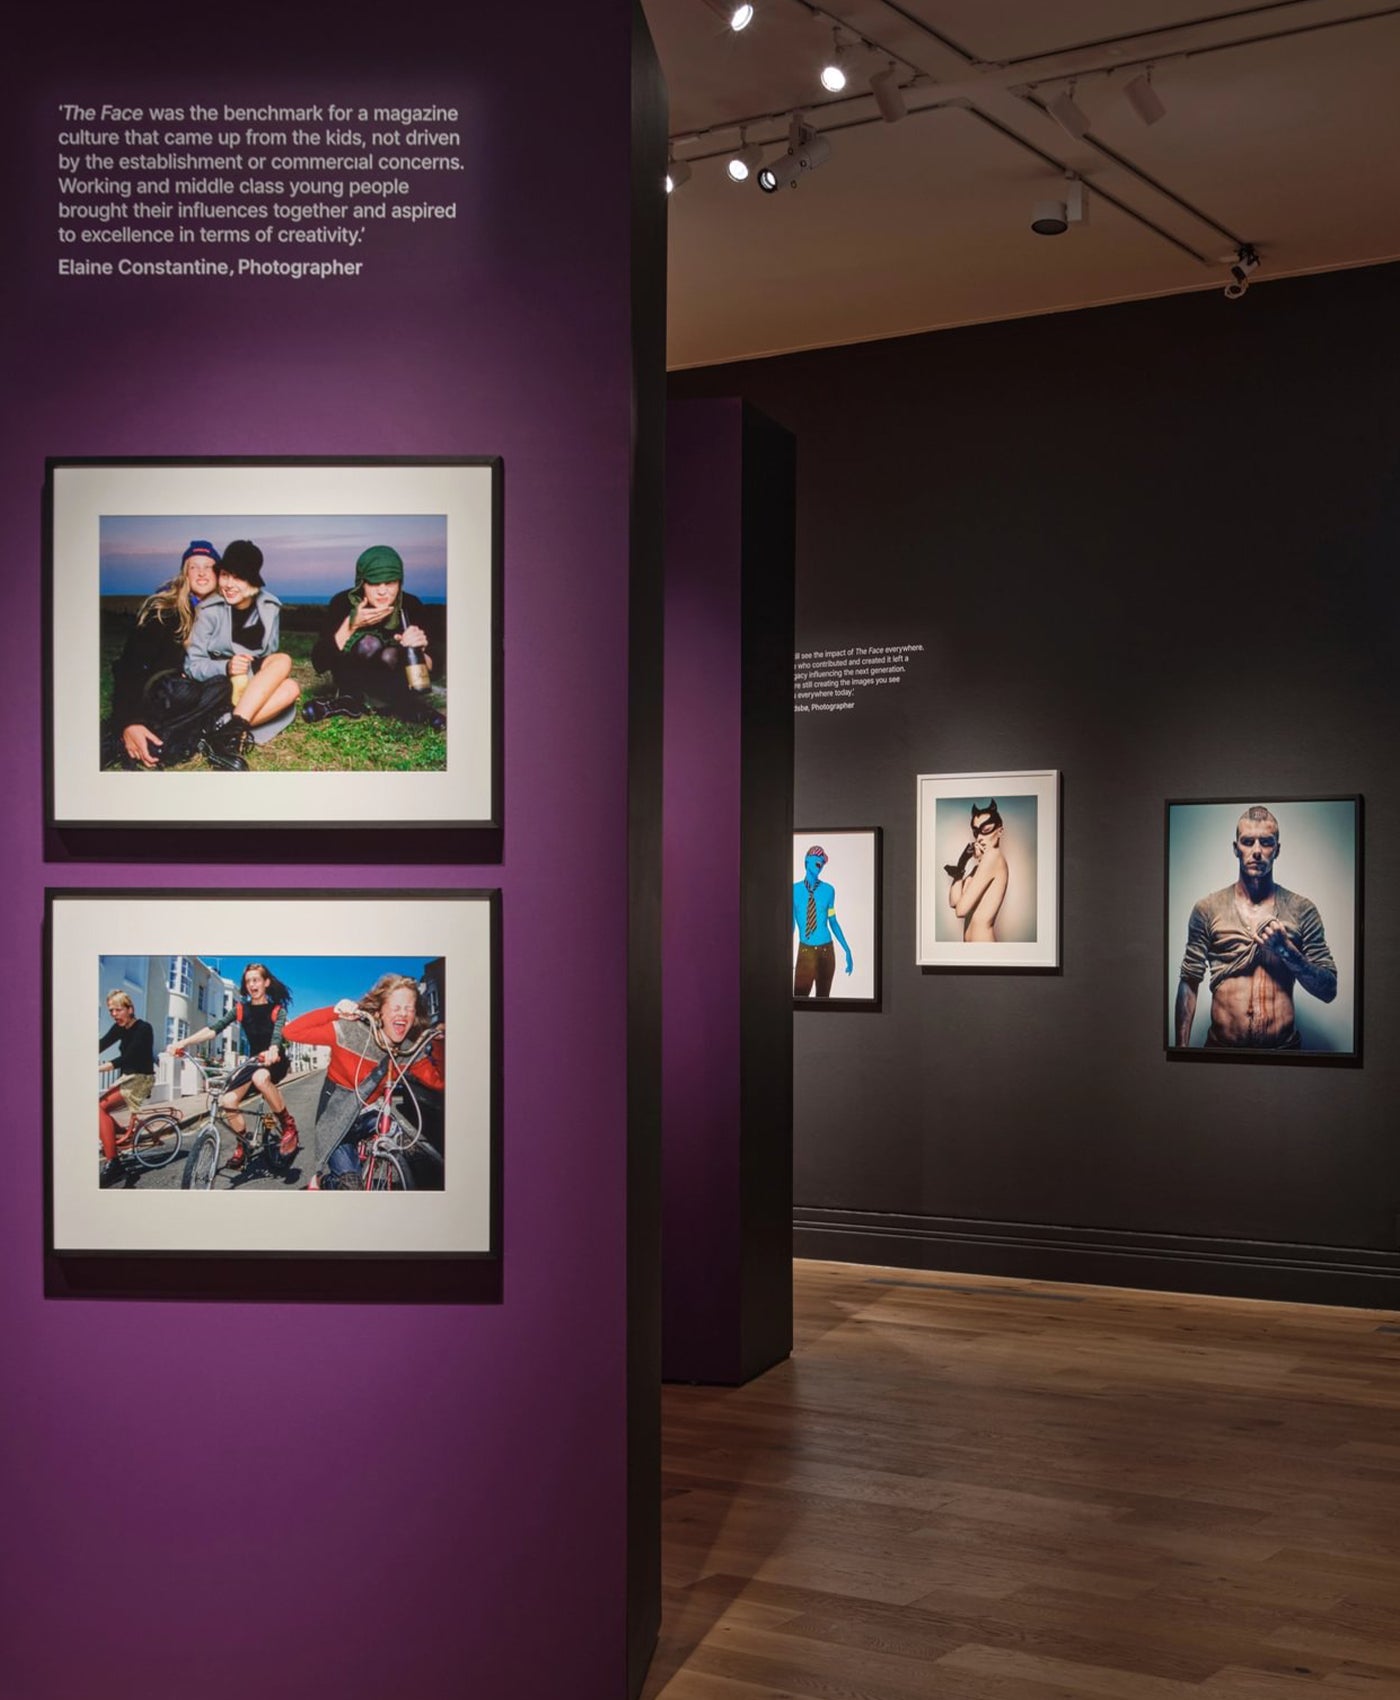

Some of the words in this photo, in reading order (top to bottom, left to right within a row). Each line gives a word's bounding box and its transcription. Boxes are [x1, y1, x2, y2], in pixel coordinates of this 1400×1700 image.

[100, 104, 143, 120] Face
[148, 107, 184, 120] was
[189, 104, 218, 120] the
[223, 104, 323, 120] benchmark
[327, 103, 353, 120] for
[357, 108, 368, 121] a
[373, 104, 458, 125] magazine
[58, 129, 119, 144] culture
[124, 129, 158, 144] that
[164, 132, 212, 145] came
[218, 132, 240, 148] up
[245, 128, 286, 145] from
[291, 129, 320, 145] the
[325, 128, 366, 148] kids,
[371, 130, 400, 145] not
[405, 128, 460, 145] driven
[58, 153, 79, 172] by
[85, 153, 113, 169] the
[118, 152, 242, 169] establishment
[247, 156, 266, 169] or
[271, 153, 372, 169] commercial
[378, 156, 464, 170] concerns.
[58, 177, 131, 197] Working
[136, 177, 169, 193] and
[175, 177, 234, 193] middle
[239, 177, 284, 193] class
[289, 181, 343, 197] young
[349, 177, 409, 197] people
[58, 202, 127, 221] brought
[133, 201, 173, 217] their
[178, 201, 268, 218] influences
[272, 202, 348, 221] together
[352, 202, 385, 218] and
[391, 201, 456, 221] aspired
[58, 227, 75, 242] to
[81, 226, 174, 242] excellence
[179, 225, 194, 242] in
[199, 227, 250, 242] terms
[254, 225, 273, 242] of
[57, 258, 112, 274] Elaine
[117, 258, 234, 277] Constantine,
[238, 258, 363, 279] Photographer
[812, 660, 848, 669] contributed
[861, 657, 886, 665] created
[886, 655, 891, 663] it
[892, 654, 903, 663] left
[824, 650, 846, 659] impact
[855, 647, 867, 655] The
[802, 681, 813, 689] still
[813, 680, 839, 689] creating
[851, 677, 874, 687] images
[875, 678, 888, 686] you
[808, 670, 843, 679] influencing
[797, 691, 834, 700] everywhere
[811, 702, 855, 712] Photographer
